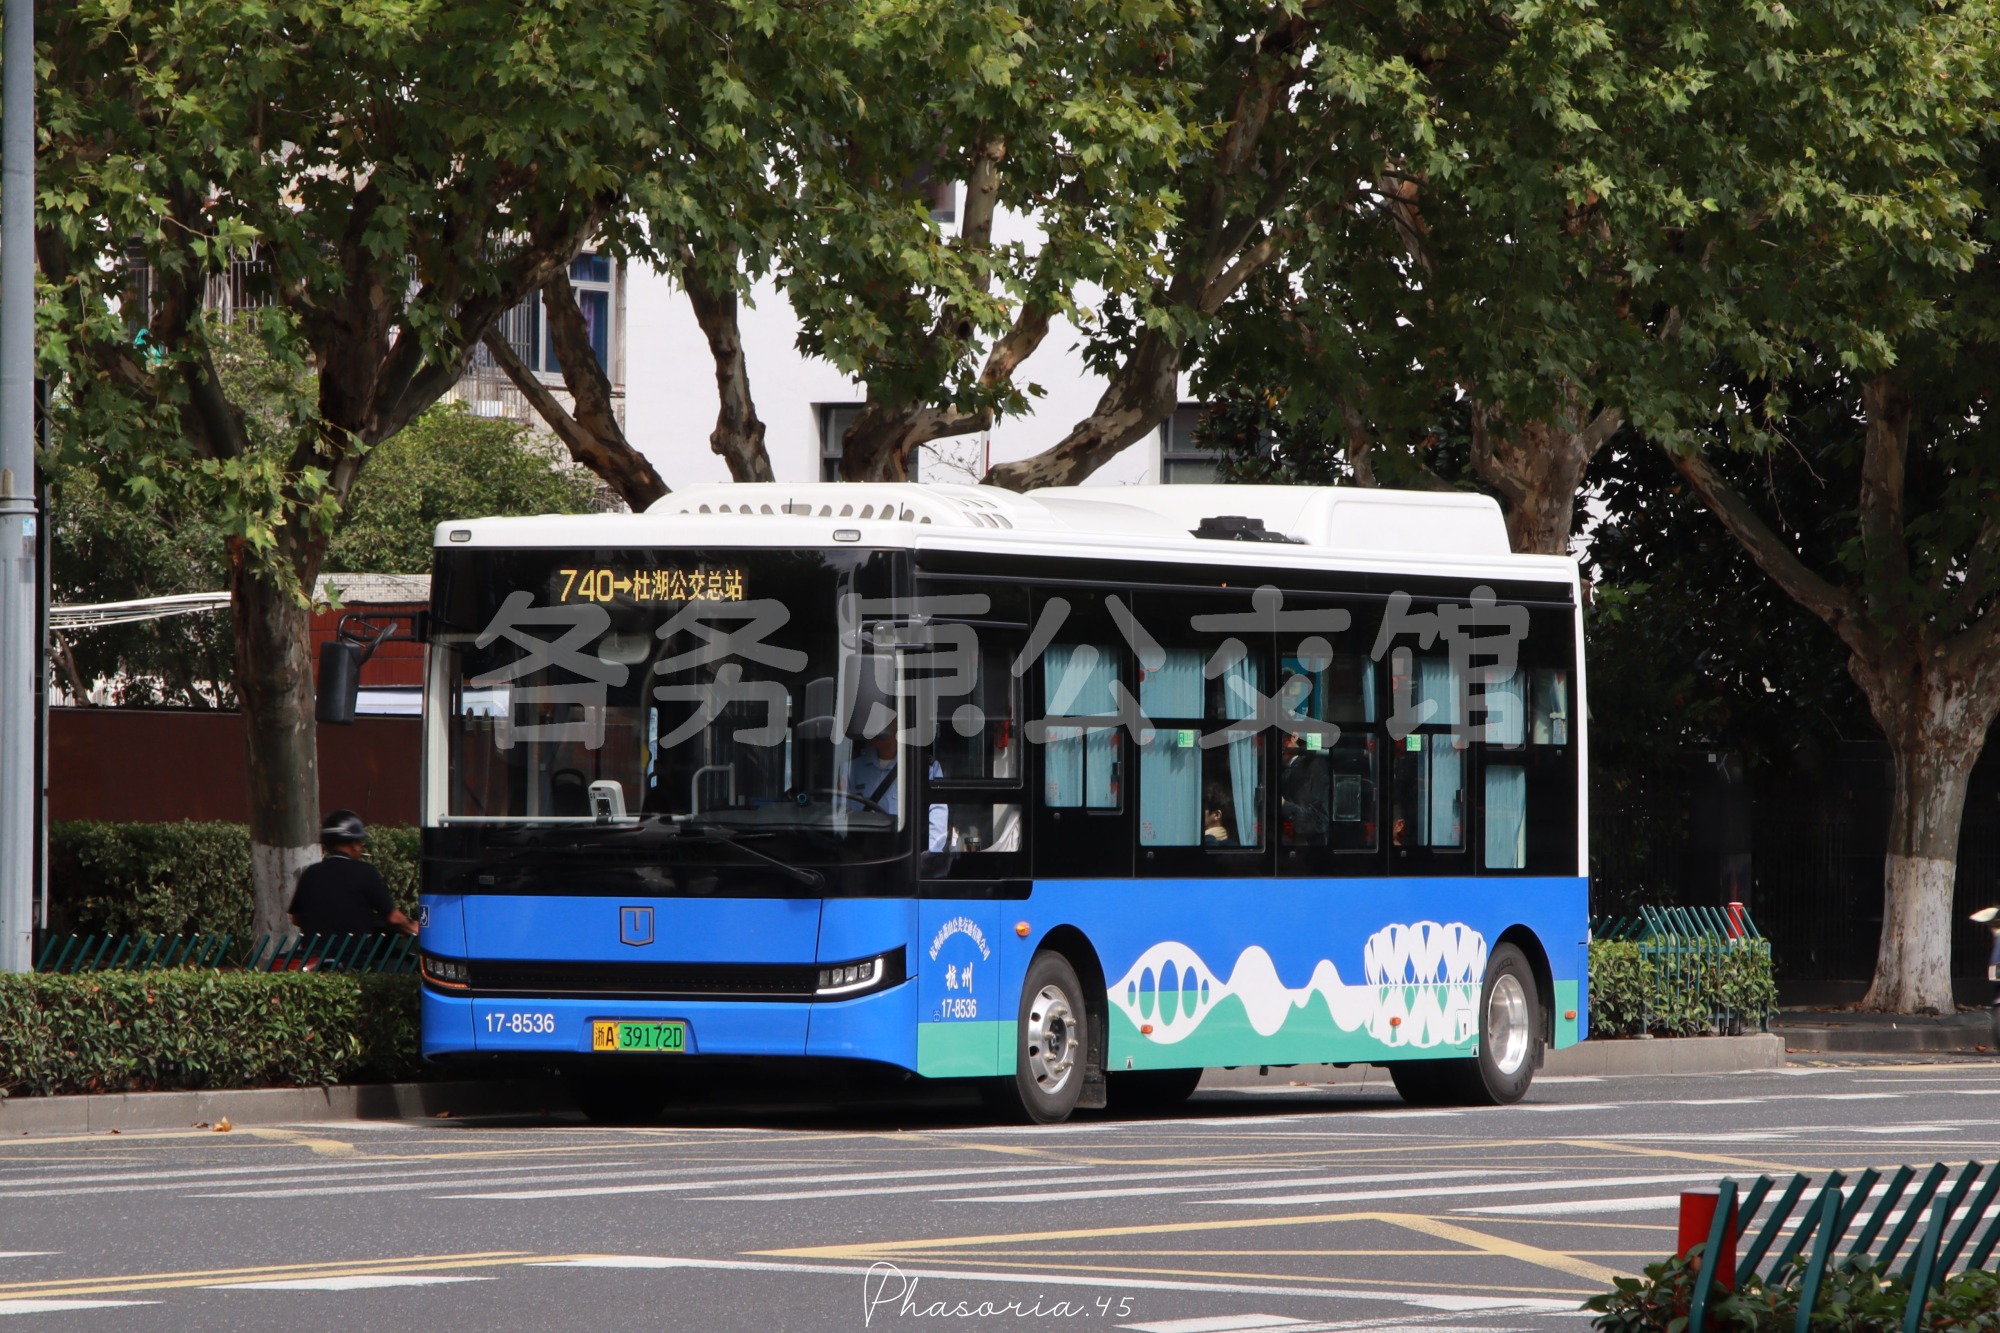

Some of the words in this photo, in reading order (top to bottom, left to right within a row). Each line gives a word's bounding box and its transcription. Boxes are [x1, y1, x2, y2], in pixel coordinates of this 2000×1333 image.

[559, 569, 614, 602] 740
[632, 569, 743, 602] 杜湖公交总站
[944, 961, 974, 994] 杭州
[941, 998, 977, 1019] 17-8536
[485, 1012, 555, 1034] 17-8536
